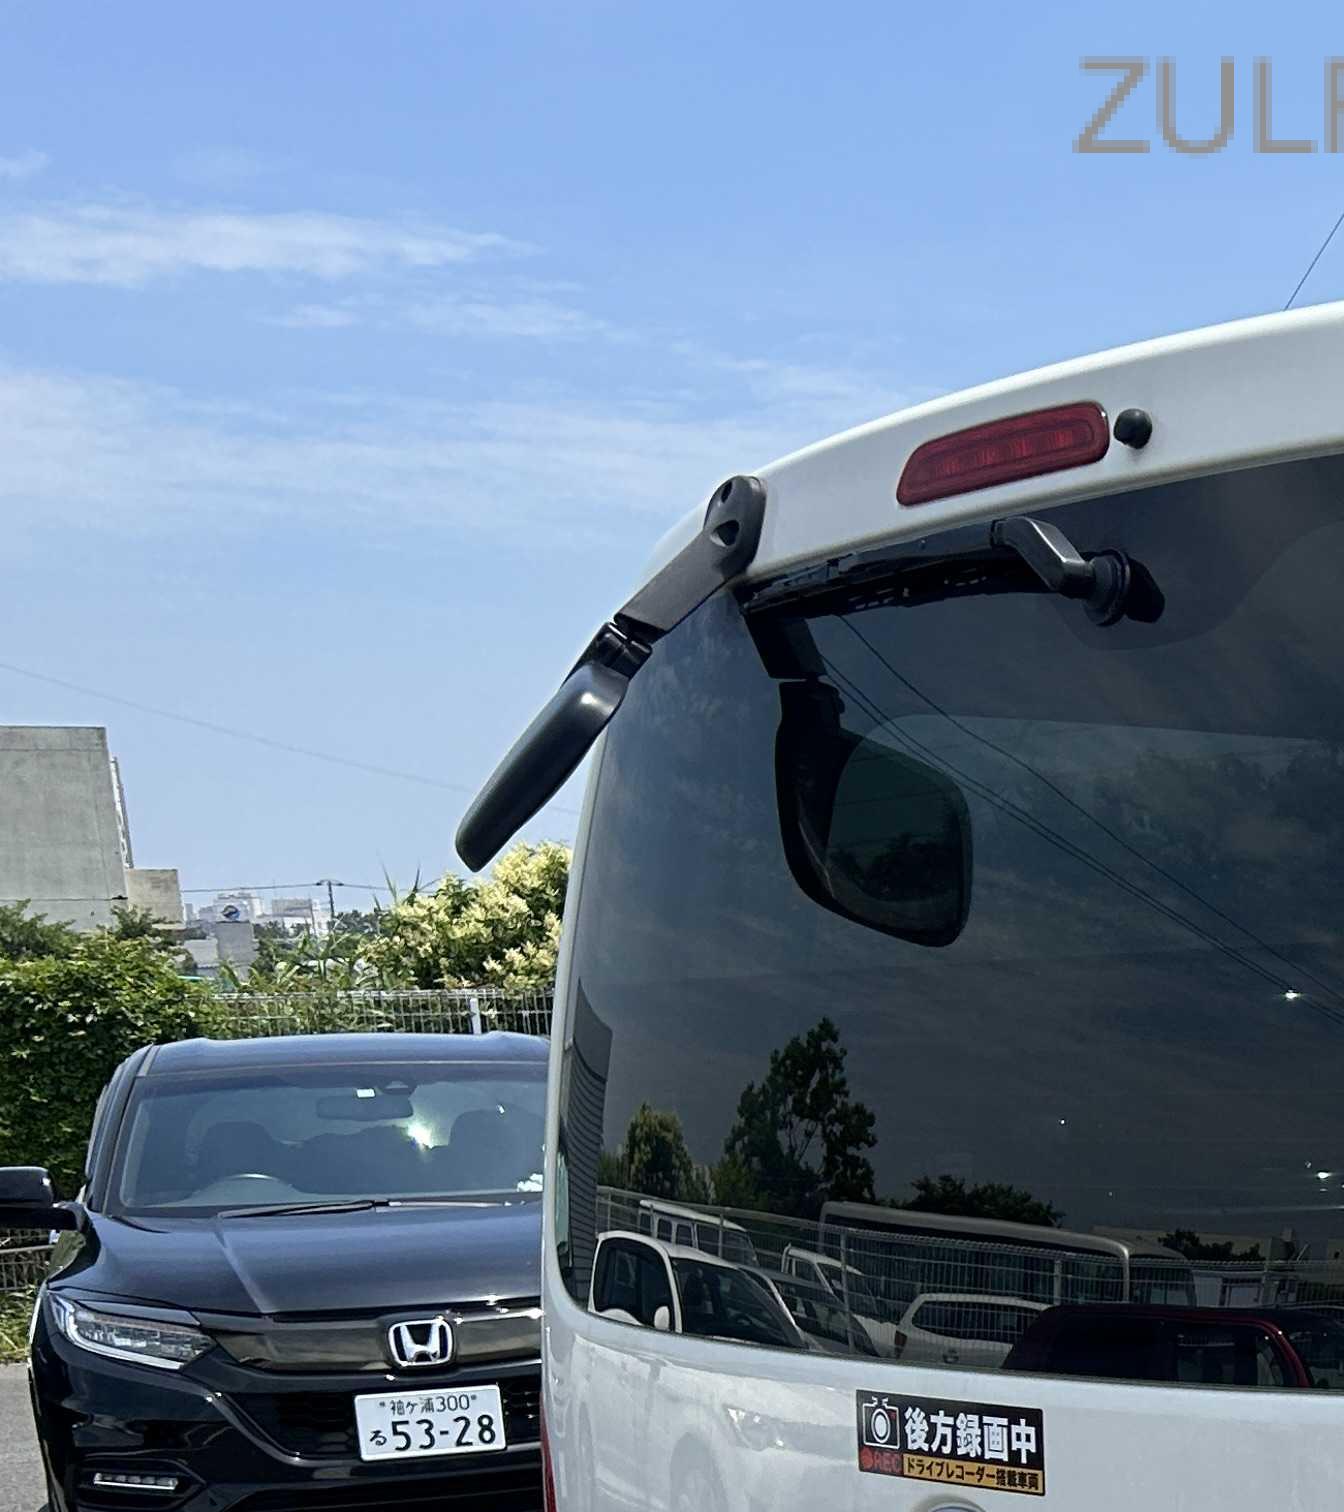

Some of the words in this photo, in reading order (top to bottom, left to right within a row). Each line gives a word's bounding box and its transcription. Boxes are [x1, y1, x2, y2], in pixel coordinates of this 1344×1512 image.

[370, 1430, 387, 1446] る
[391, 1414, 496, 1451] 53-28
[904, 1406, 1036, 1464] 後方録画中
